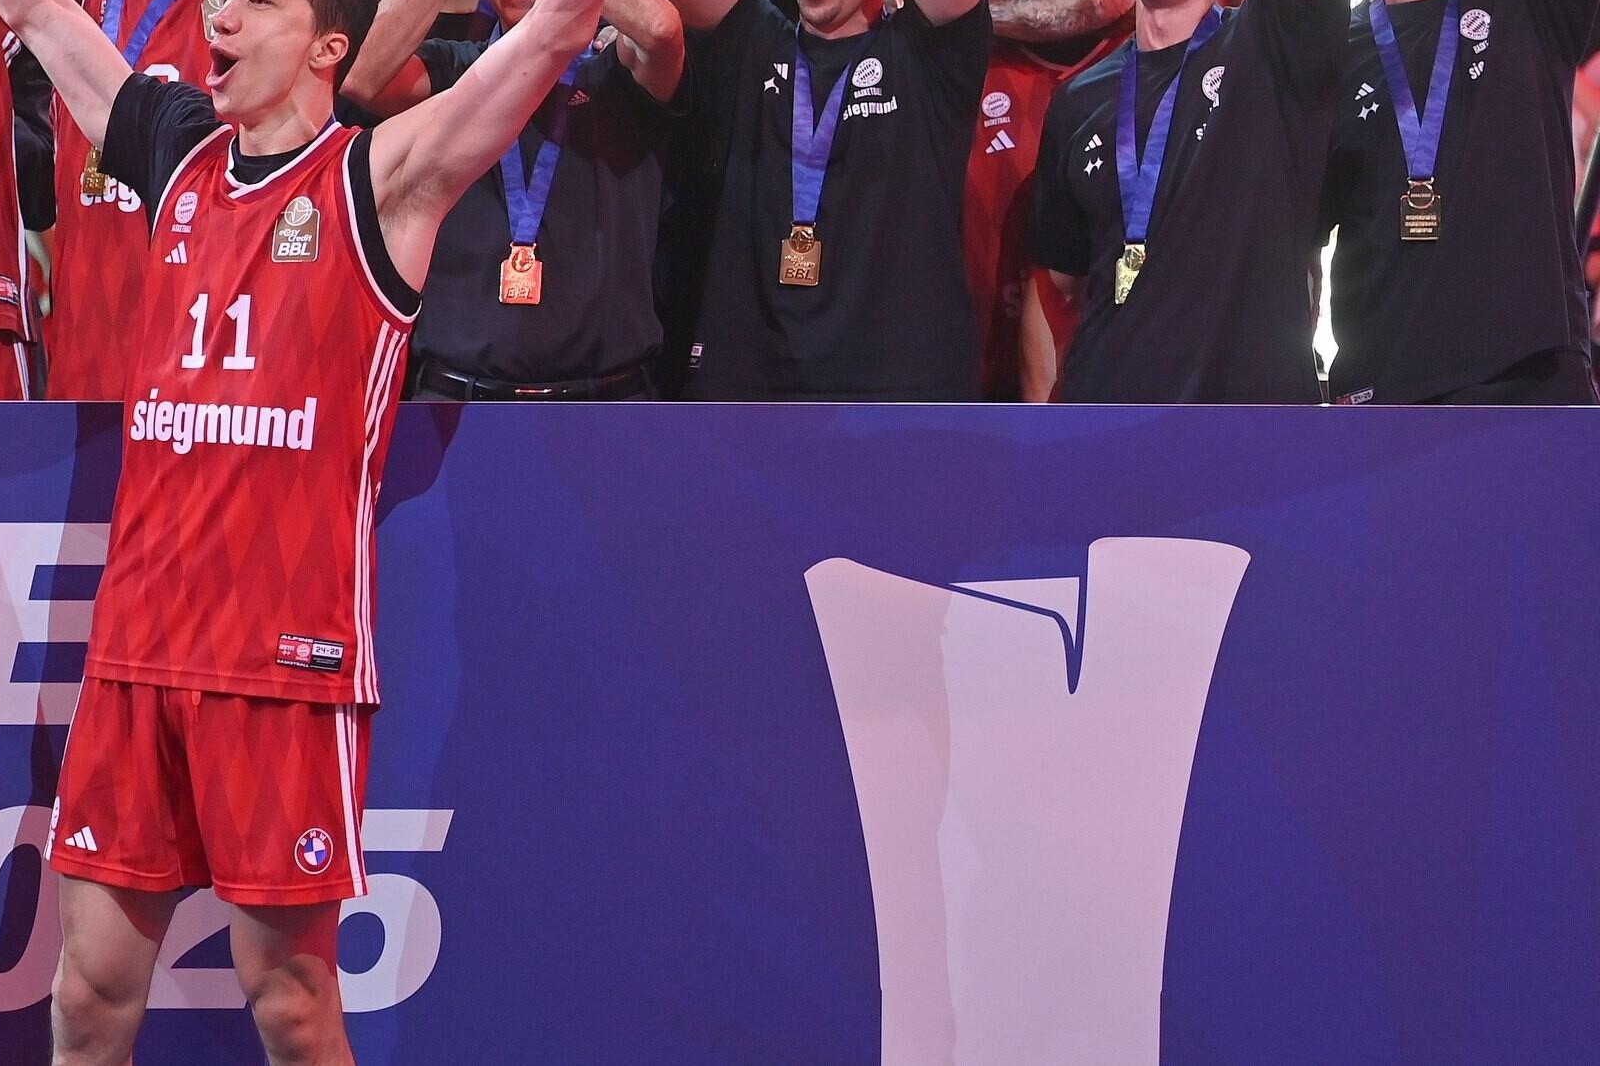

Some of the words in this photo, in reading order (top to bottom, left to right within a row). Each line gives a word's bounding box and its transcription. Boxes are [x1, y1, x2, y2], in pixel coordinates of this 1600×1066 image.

[842, 95, 899, 122] siegmund
[276, 241, 311, 257] BBL
[784, 267, 816, 281] BBL
[180, 292, 257, 371] 11
[130, 388, 318, 455] siegmund
